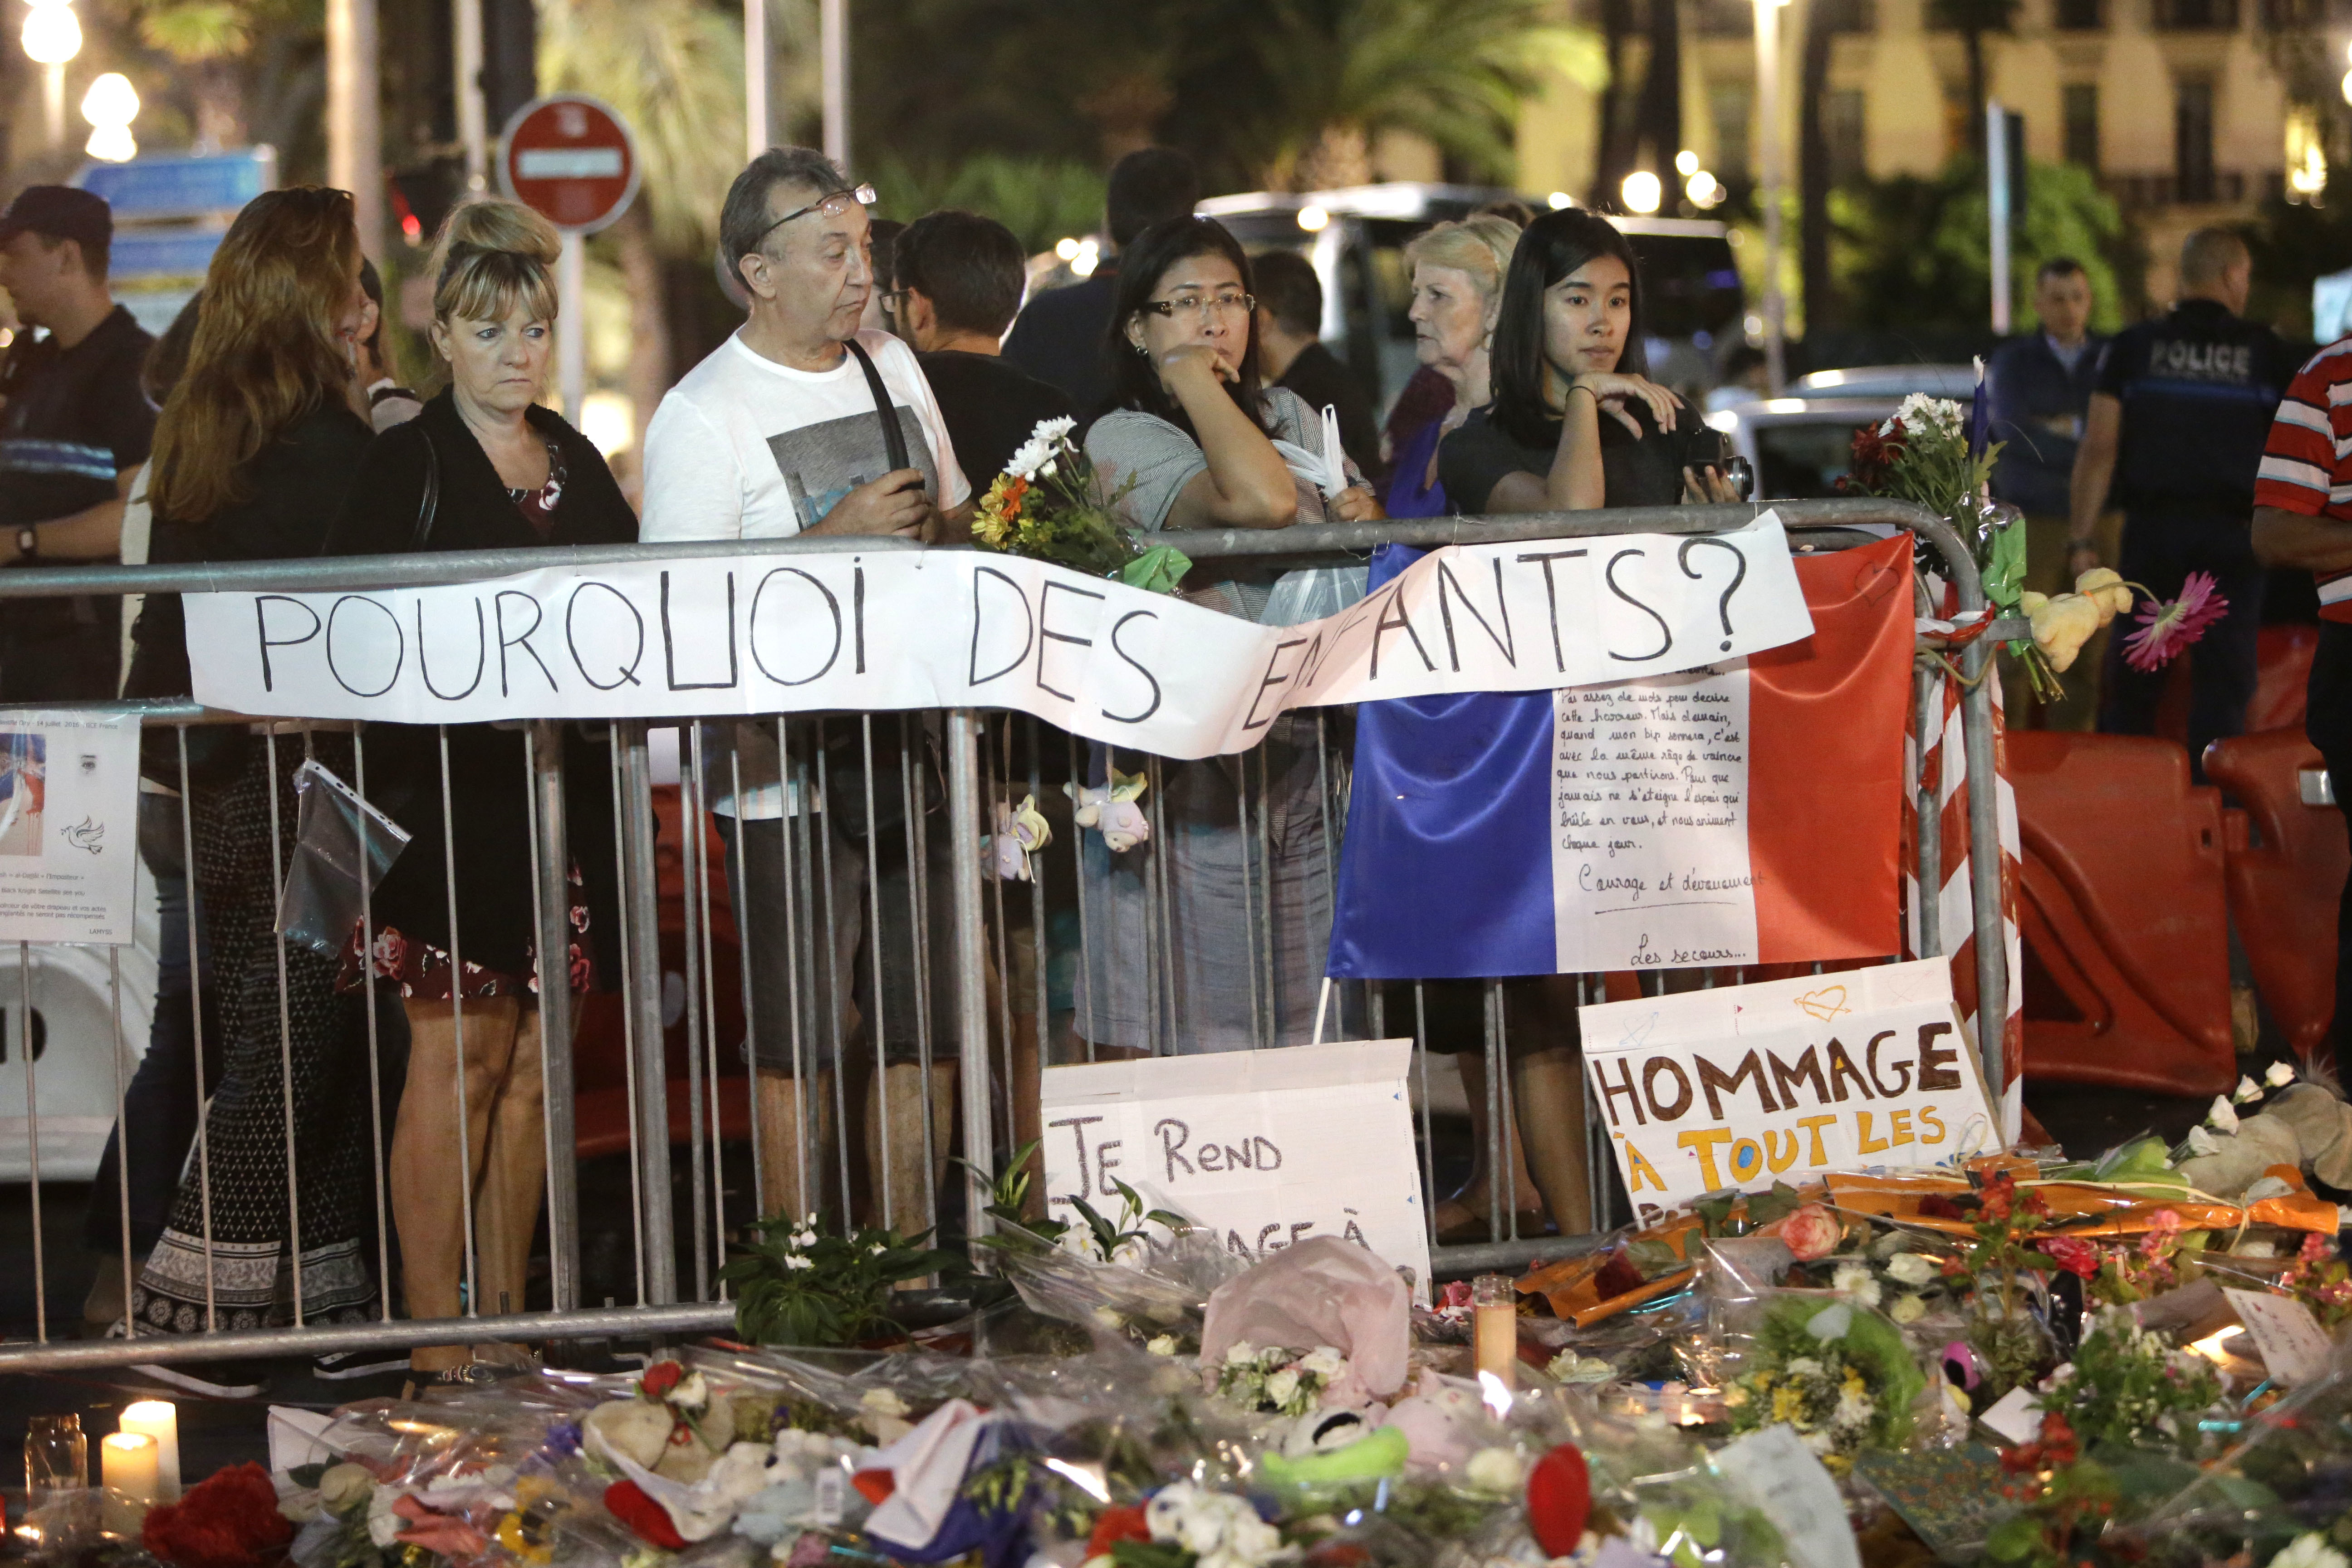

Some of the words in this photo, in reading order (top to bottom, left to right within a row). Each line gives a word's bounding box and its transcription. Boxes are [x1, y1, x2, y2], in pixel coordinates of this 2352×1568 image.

[2150, 339, 2250, 375] POLICE
[969, 566, 1161, 723] DES
[1558, 686, 1577, 703] Pas
[1583, 693, 1614, 706] assez
[1618, 691, 1635, 701] de
[1638, 691, 1661, 702] mots
[1666, 695, 1687, 707] pour
[1651, 706, 1676, 720] Mais
[1681, 710, 1730, 727] demain,
[1560, 727, 1595, 747] quand
[1608, 731, 1636, 740] mon
[1645, 727, 1660, 742] bip
[1714, 728, 1740, 742] c'est
[1559, 751, 1582, 761] avec
[1590, 747, 1608, 760] la
[1616, 749, 1655, 760] même
[1687, 750, 1698, 761] de
[1703, 751, 1742, 763] vaincre
[1557, 769, 1578, 783] que
[1587, 771, 1616, 780] nous
[1622, 768, 1678, 783] partirons.
[1681, 765, 1706, 783] Pour
[1712, 774, 1729, 785] que
[1558, 786, 1602, 808] jamais
[1723, 791, 1740, 809] qui
[1561, 811, 1592, 827] brûle
[1657, 810, 1668, 825] et
[1672, 816, 1694, 826] nous
[1608, 836, 1642, 858] jour.
[1579, 863, 1647, 901] Courage
[1659, 872, 1674, 891] et
[1631, 933, 1661, 965] Les
[1671, 949, 1745, 963] secours...
[1592, 1022, 1961, 1126] HOMMAGE
[1049, 1115, 1123, 1205] JE
[1613, 1132, 1667, 1192] À
[1677, 1114, 1837, 1192] TOUT
[1856, 1105, 1945, 1155] LES
